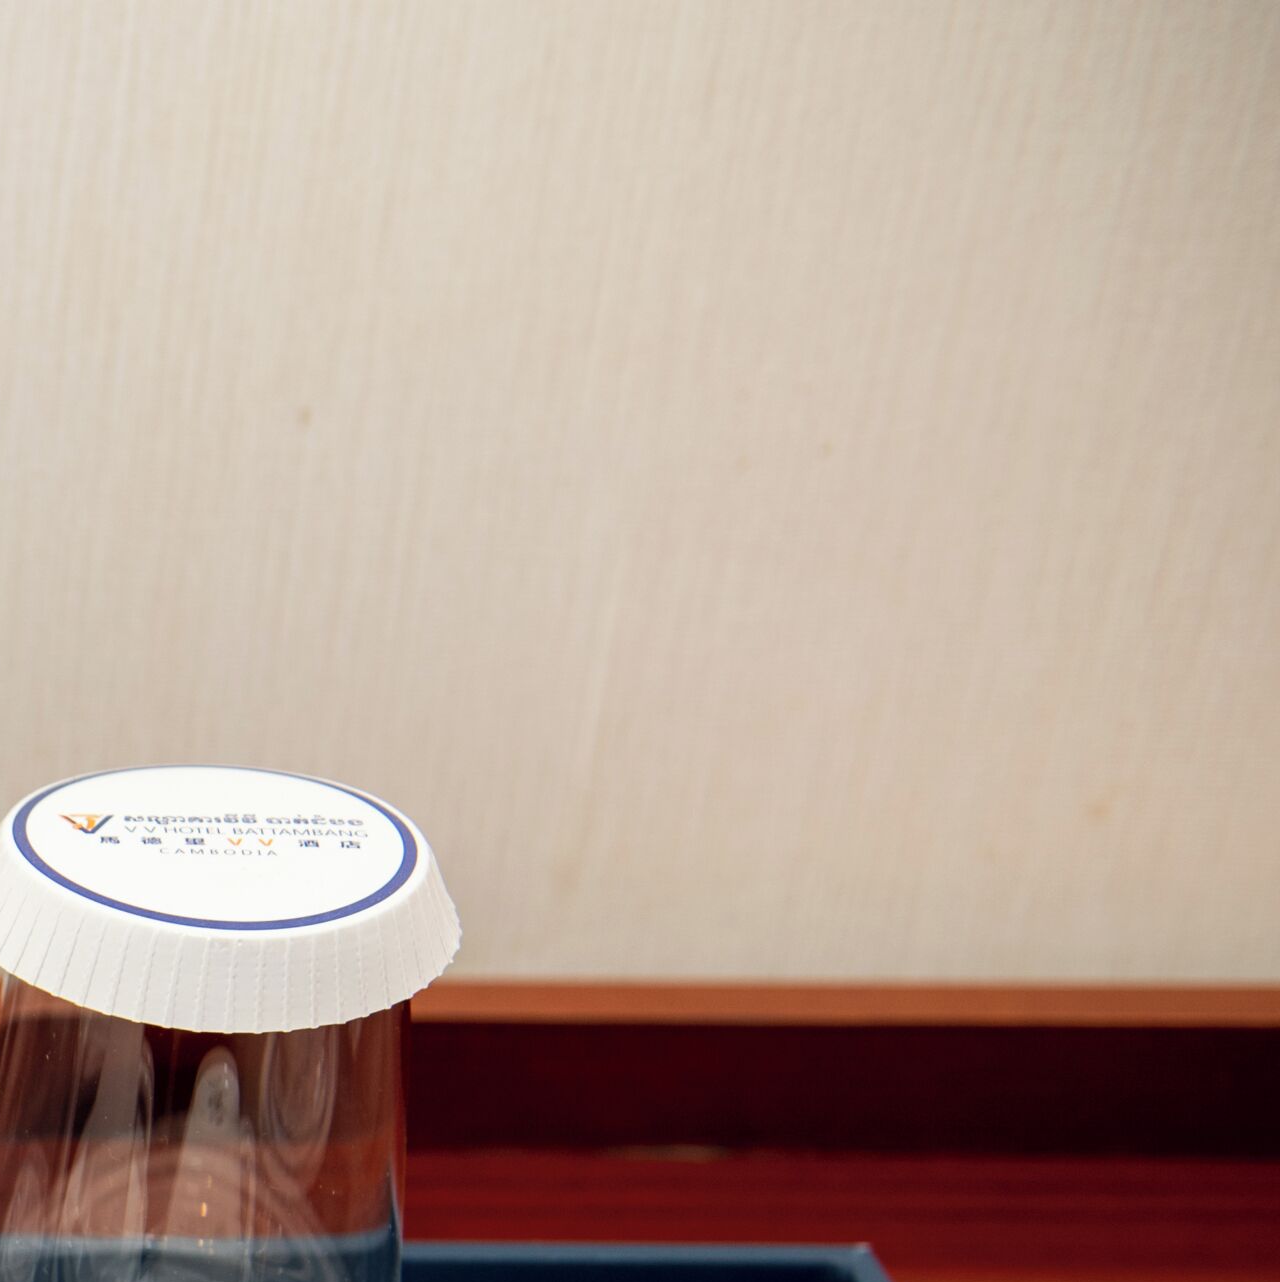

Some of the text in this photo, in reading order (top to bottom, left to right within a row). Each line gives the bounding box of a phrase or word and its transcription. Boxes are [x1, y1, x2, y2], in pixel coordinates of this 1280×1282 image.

[164, 826, 225, 835] HOTEL
[232, 827, 369, 838] BATTAMBANG
[159, 847, 279, 857] CAMBODIA
